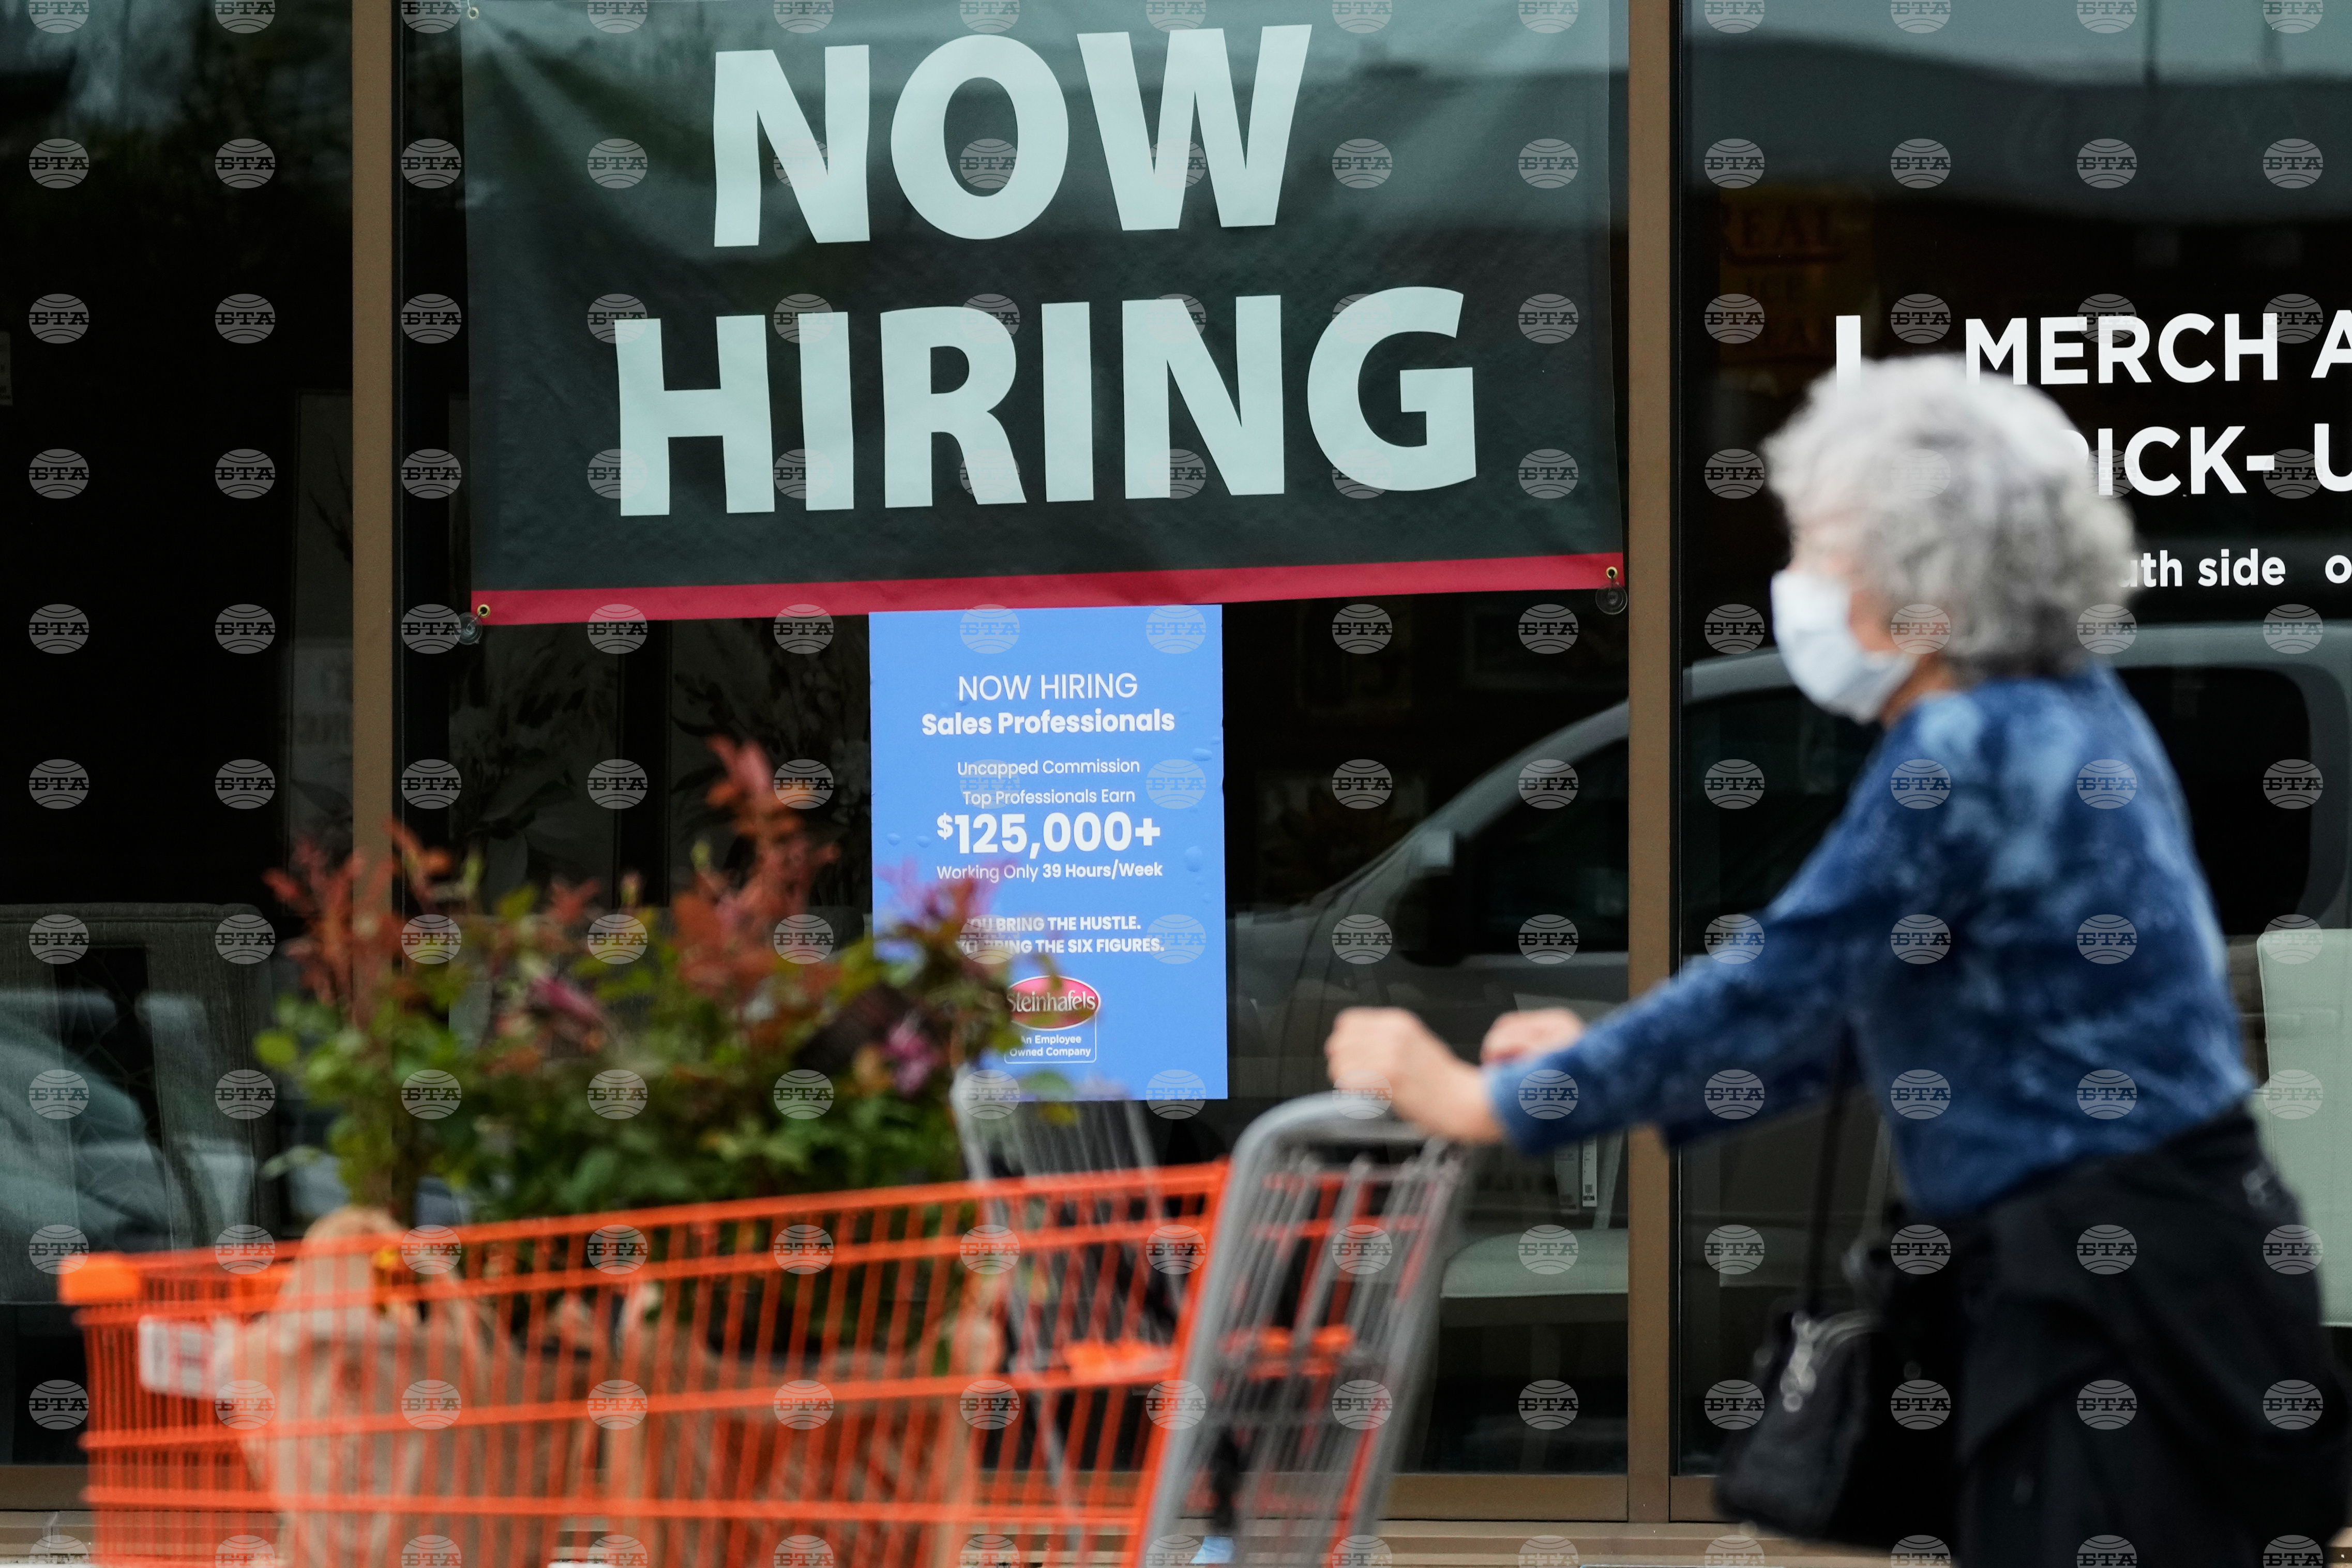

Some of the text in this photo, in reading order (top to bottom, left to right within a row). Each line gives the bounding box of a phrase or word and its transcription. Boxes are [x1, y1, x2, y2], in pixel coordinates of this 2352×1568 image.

[713, 24, 1312, 247] NOW
[1965, 312, 2278, 385] MERCH
[614, 287, 1476, 516] HIRING
[2198, 548, 2286, 586] side
[959, 672, 1138, 701] NOW HIRING
[922, 707, 1175, 735] Sales Professionals
[957, 758, 1140, 779] Uncapped Commission
[962, 789, 1135, 809] Top Professionals Earn
[937, 811, 1160, 859] $125,000+
[937, 859, 1163, 883] Working Only 39 Hours/Week
[996, 917, 1045, 931] BRING
[1047, 916, 1077, 931] THE
[1080, 916, 1141, 930] HUSTLE.
[1035, 939, 1065, 953] THE
[1067, 939, 1093, 953] SIX
[1096, 938, 1165, 952] FIGURES.
[1007, 990, 1096, 1012] Steinhafels
[1034, 1034, 1082, 1045] Employee
[1010, 1047, 1091, 1058] Owned Company
